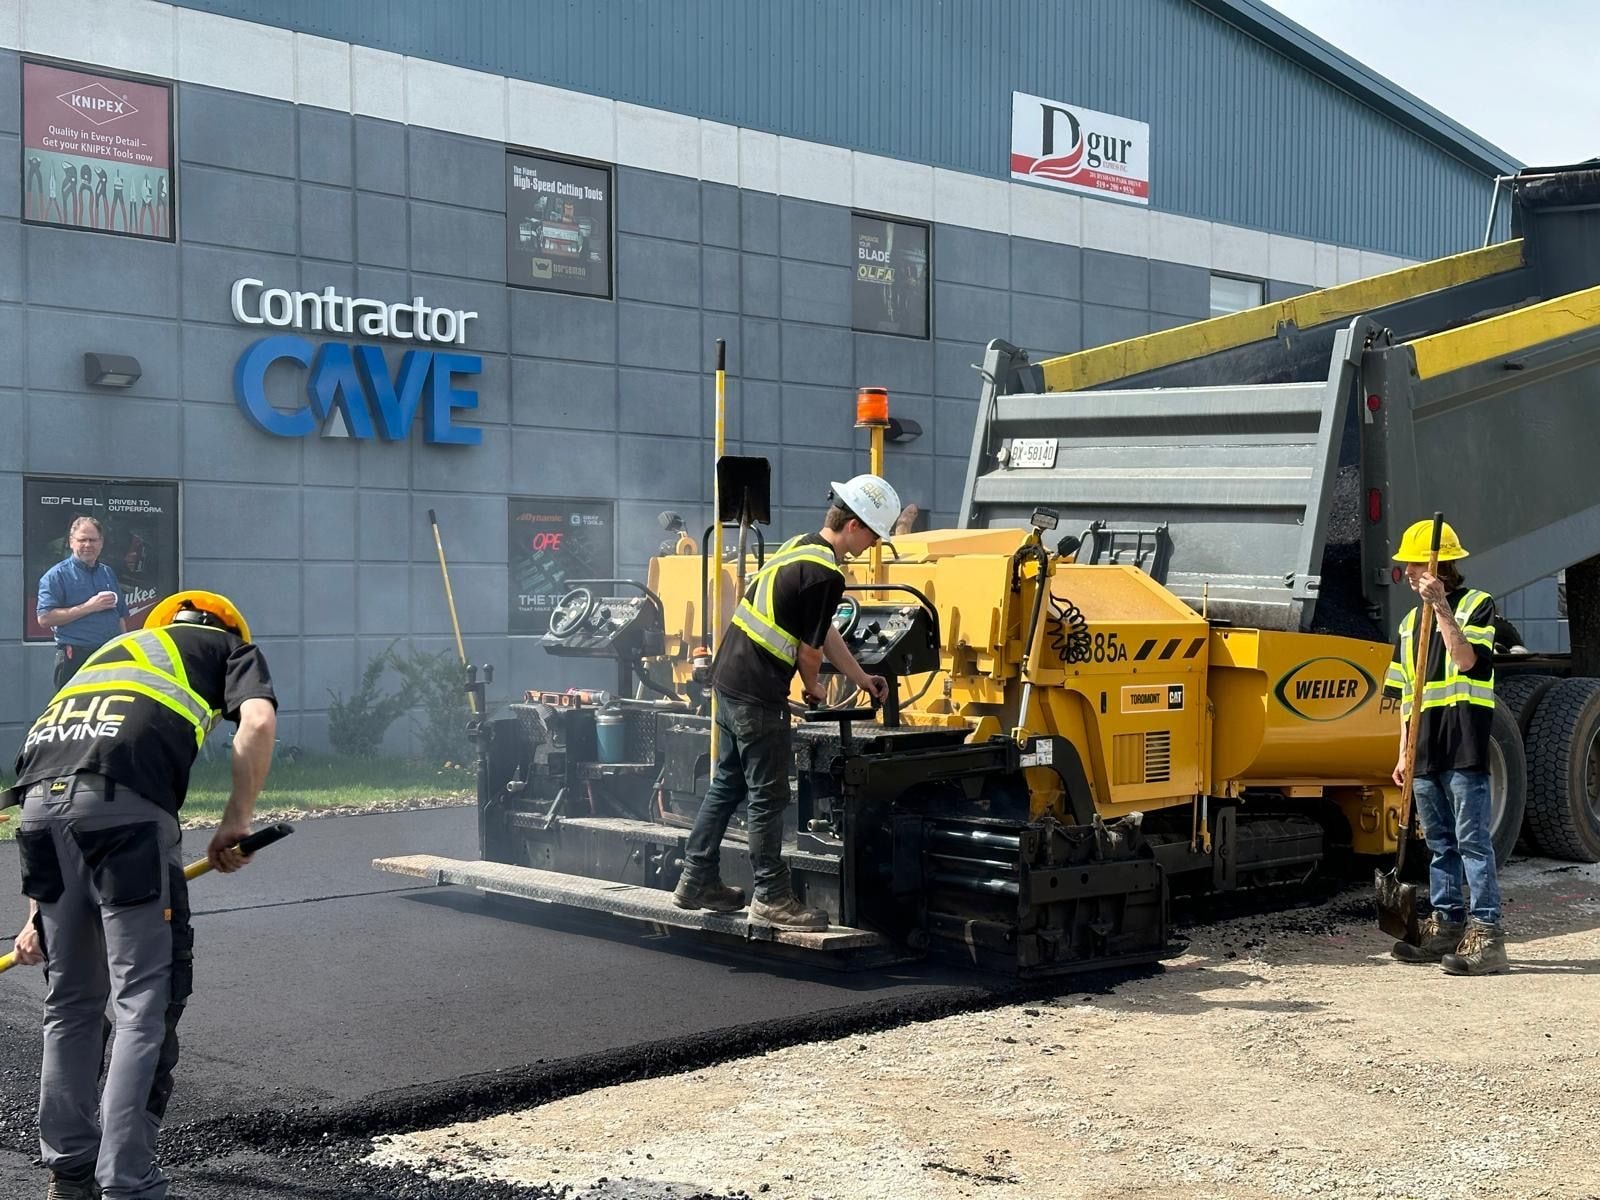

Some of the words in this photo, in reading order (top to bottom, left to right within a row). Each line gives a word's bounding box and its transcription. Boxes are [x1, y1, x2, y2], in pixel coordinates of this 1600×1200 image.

[71, 94, 124, 114] KNIPEX
[48, 125, 79, 140] Quality
[81, 129, 89, 140] in
[91, 131, 114, 145] Every
[115, 135, 140, 148] Detail
[1040, 103, 1132, 168] Dgur
[42, 136, 58, 147] Get
[60, 140, 79, 151] your
[81, 142, 111, 157] KNIPEX
[113, 147, 134, 160] Tools
[135, 152, 153, 163] now
[513, 165, 522, 175] The
[513, 174, 556, 193] High-Speed
[556, 181, 583, 200] Cutting
[584, 186, 603, 201] Tools
[858, 247, 890, 263] BLADE
[859, 266, 893, 281] OLFA
[231, 278, 478, 344] Contractor
[234, 335, 482, 445] CAVE
[61, 497, 103, 506] FUEL
[518, 595, 546, 605] THE
[1130, 693, 1160, 705] TOROMONT
[1169, 691, 1182, 704] CAT
[1295, 679, 1359, 700] WEILER
[28, 694, 136, 735] AHC
[25, 721, 123, 752] PAVING
